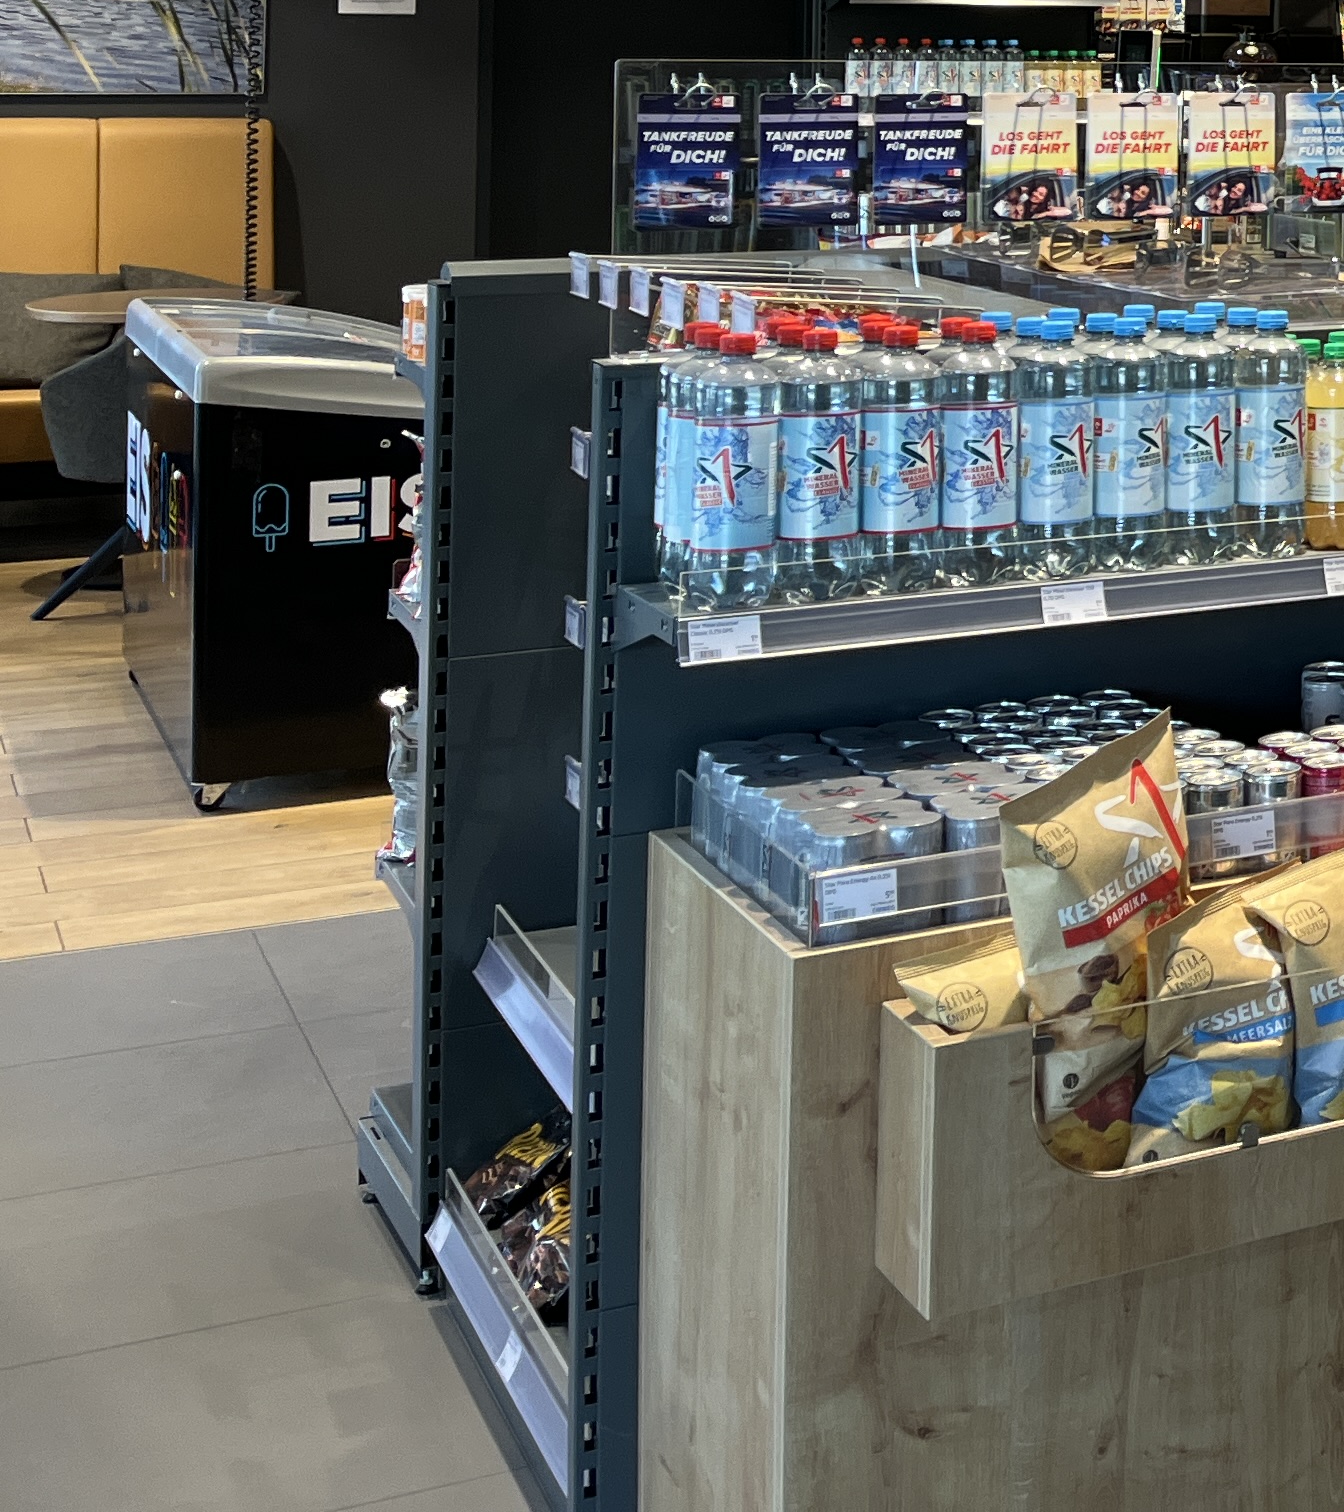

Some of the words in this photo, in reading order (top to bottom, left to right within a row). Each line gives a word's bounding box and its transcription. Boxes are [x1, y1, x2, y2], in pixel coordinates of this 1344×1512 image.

[643, 131, 735, 143] TANKFREUDE
[765, 130, 854, 142] TANKFREUDE
[879, 129, 963, 141] TANKFREUDE
[999, 131, 1024, 142] LOS
[1028, 130, 1063, 141] GEHT
[1102, 131, 1127, 141] LOS
[1129, 130, 1166, 141] GEHT
[1202, 130, 1227, 140] LOS
[1229, 129, 1263, 140] GEHT
[650, 143, 672, 153] FÜR
[772, 142, 794, 153] FÜR
[886, 141, 906, 152] FÜR
[991, 143, 1017, 155] DIE
[1020, 142, 1071, 155] FAHRT
[1094, 142, 1120, 155] DIE
[1122, 142, 1172, 154] FAHRT
[1194, 141, 1219, 153] DIE
[1221, 141, 1270, 153] FAHRT
[1298, 143, 1324, 156] FÜR
[669, 150, 726, 164] DICH!
[792, 147, 845, 163] DICH!
[905, 146, 956, 162] DICH!
[1039, 826, 1069, 850] EXTRA
[1057, 871, 1126, 928] KESSEL
[1123, 847, 1174, 898] CHIPS
[1106, 891, 1149, 929] PAPRIKA
[1287, 907, 1318, 930] EXTRA
[944, 989, 976, 1011] EXTRA
